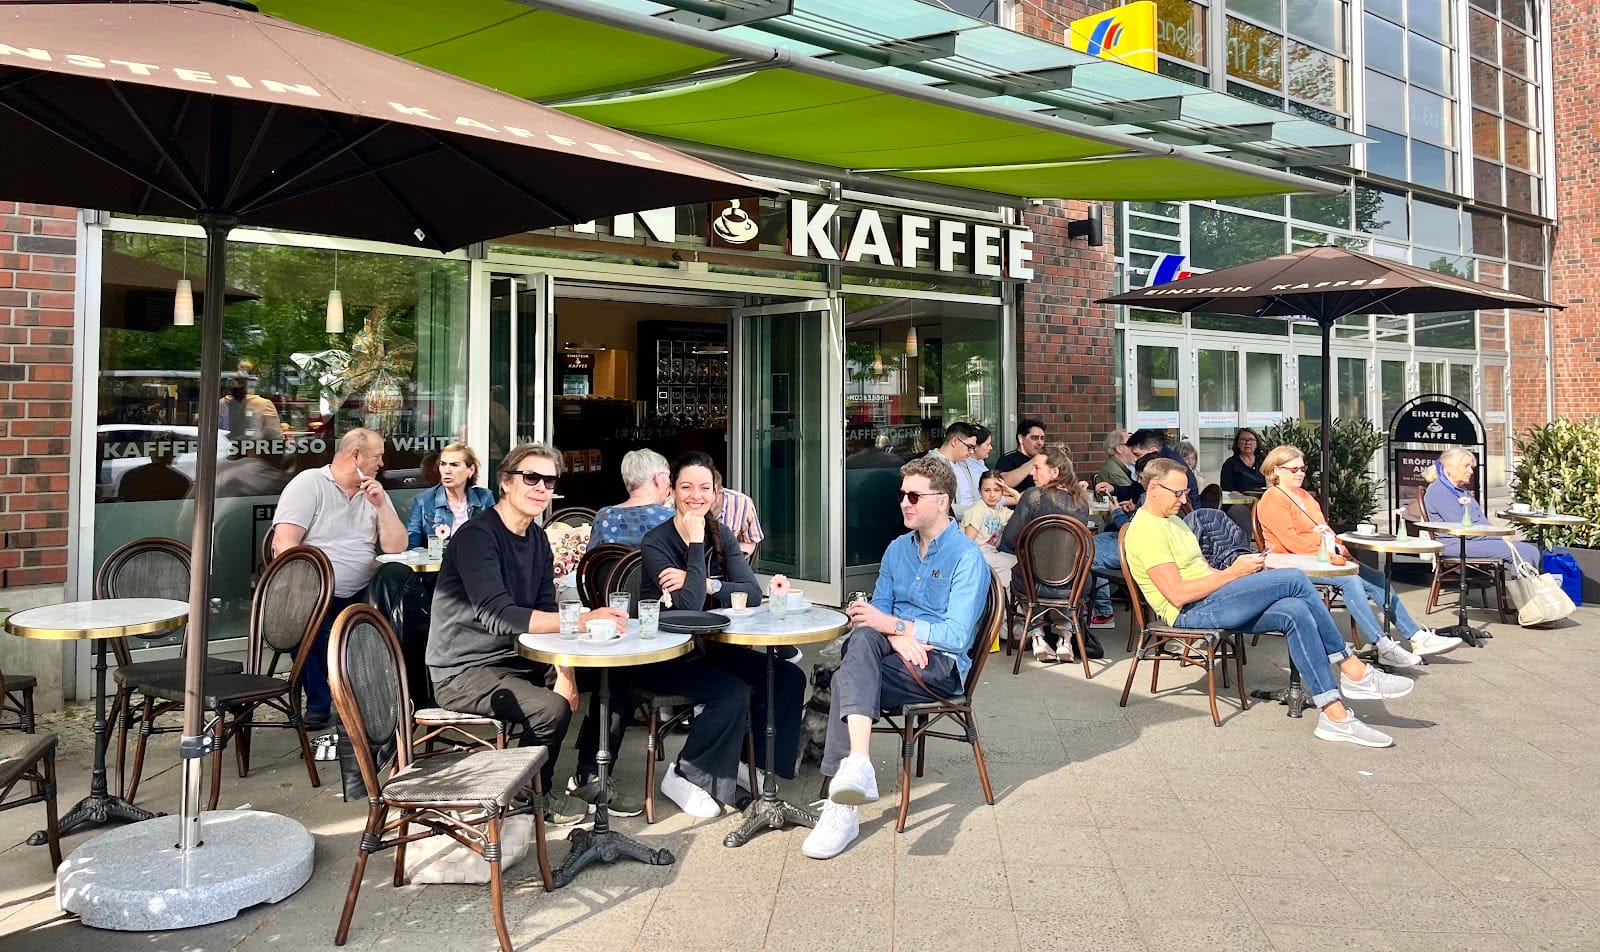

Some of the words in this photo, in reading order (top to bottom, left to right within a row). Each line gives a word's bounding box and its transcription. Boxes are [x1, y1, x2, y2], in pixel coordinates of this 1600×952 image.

[388, 101, 664, 163] KAFFEE
[791, 198, 1034, 280] KAFFEE
[1143, 286, 1252, 295] EINSTEIN
[1271, 278, 1387, 291] KAFFEE
[1411, 410, 1459, 418] EINSTEIN
[1414, 431, 1457, 440] KAFFEE
[229, 438, 326, 456] SPRESSO
